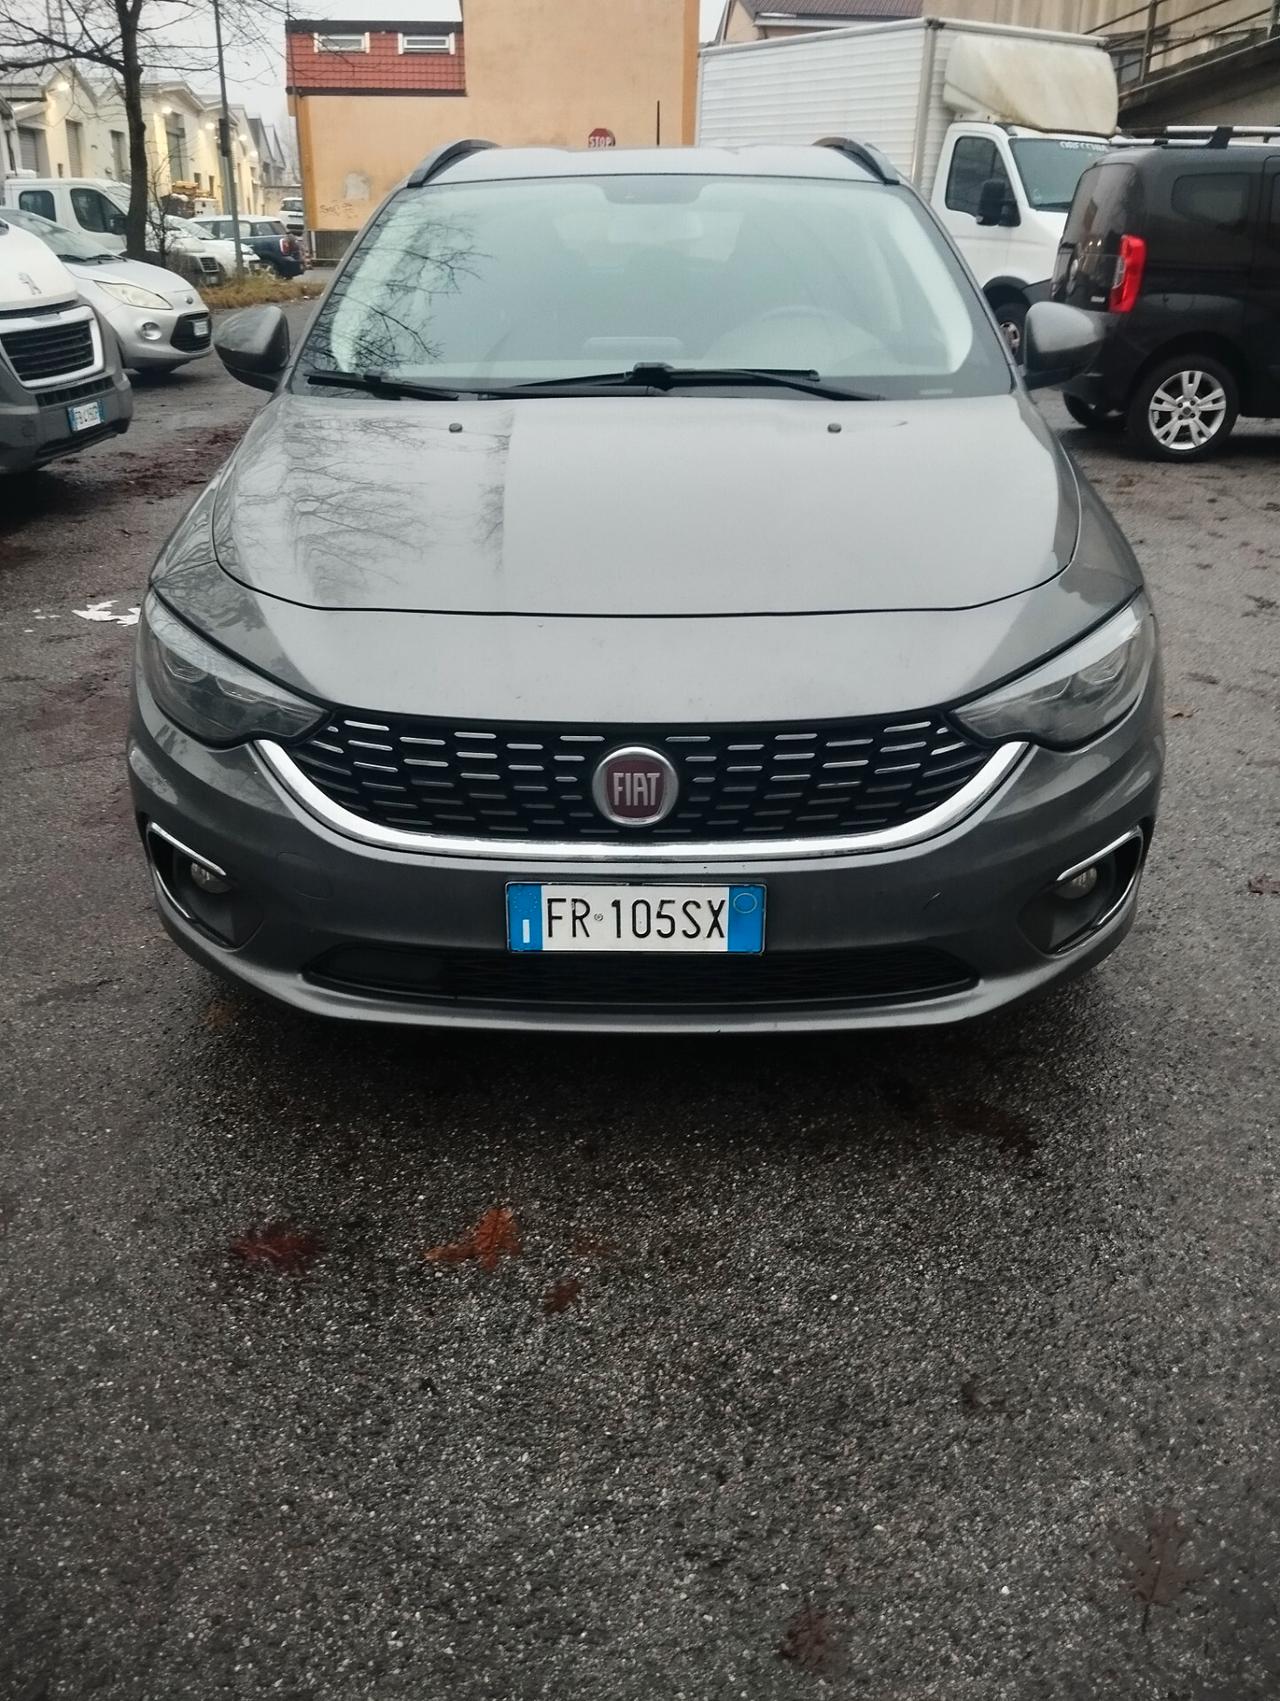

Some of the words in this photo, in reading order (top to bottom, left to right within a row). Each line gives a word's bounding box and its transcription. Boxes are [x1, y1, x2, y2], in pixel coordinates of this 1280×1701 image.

[590, 135, 612, 148] STOP
[613, 772, 660, 806] FIAT
[547, 898, 591, 938] FR
[611, 899, 726, 939] 105SX
